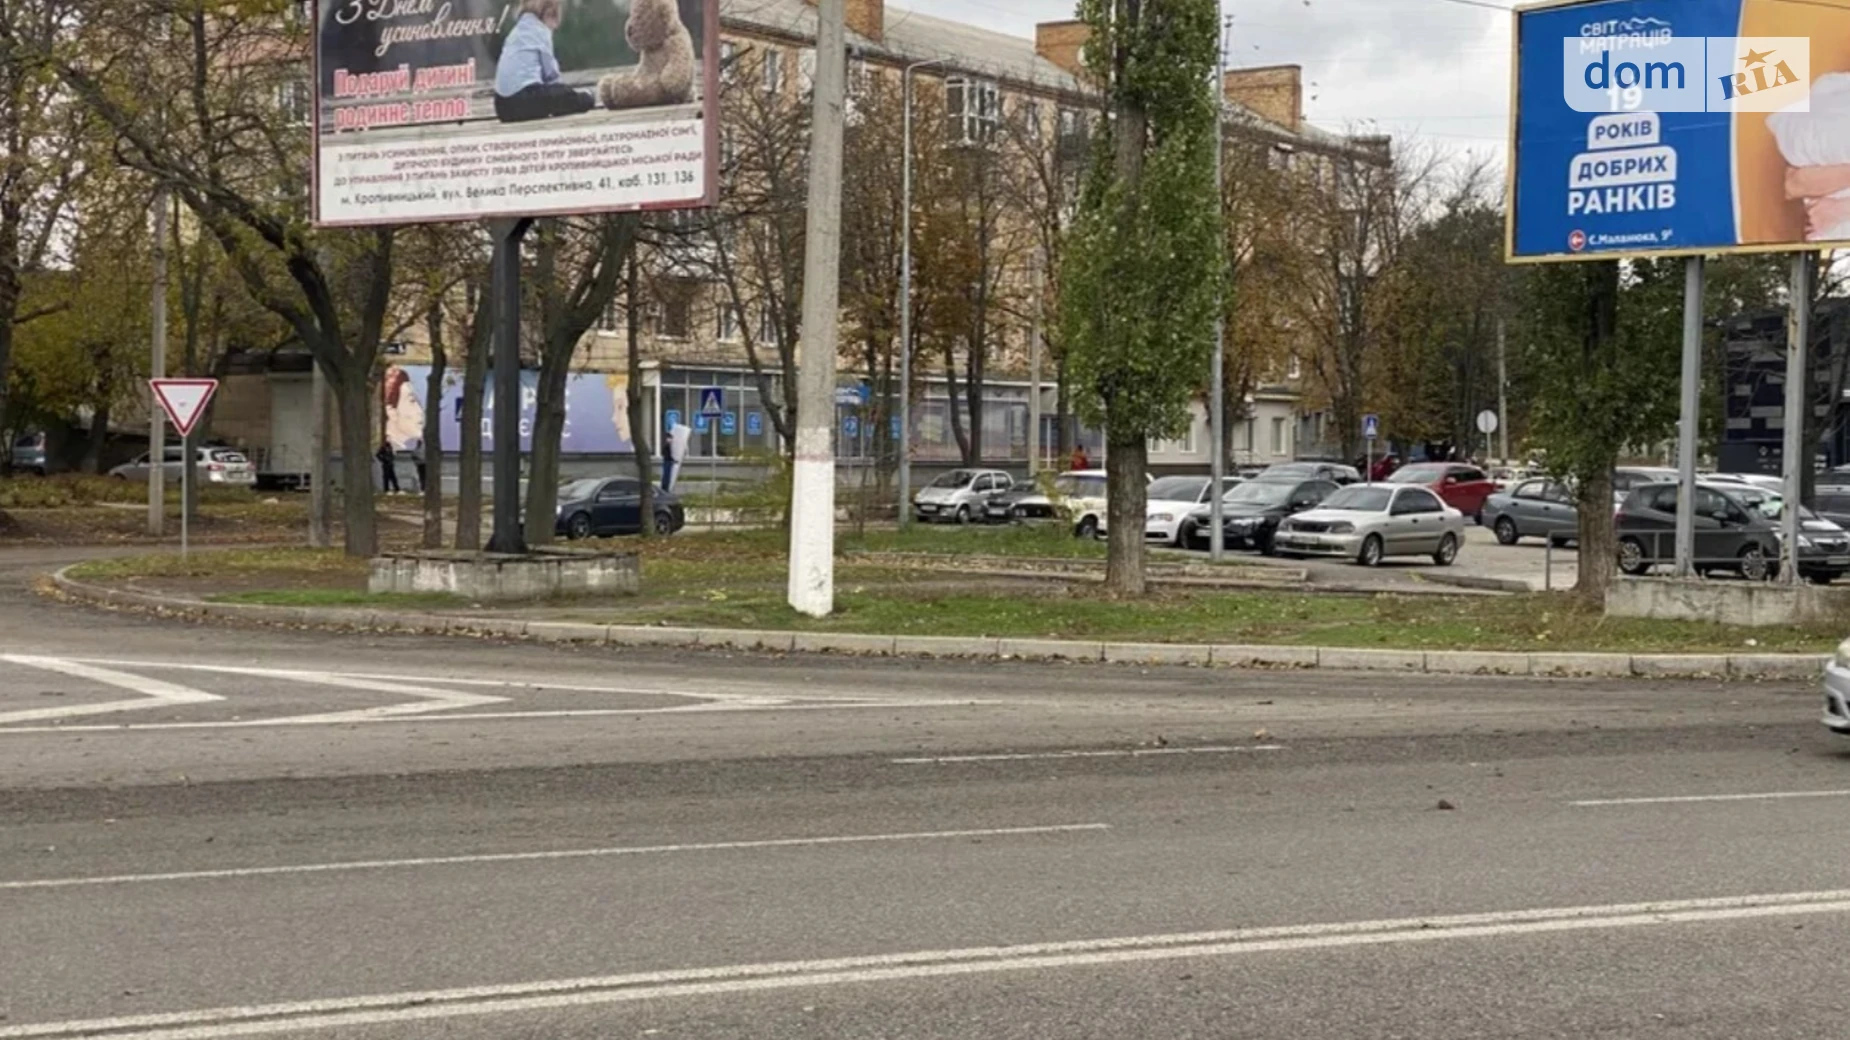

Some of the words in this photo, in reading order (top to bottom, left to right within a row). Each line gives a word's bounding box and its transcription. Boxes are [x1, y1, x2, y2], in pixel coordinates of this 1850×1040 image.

[375, 2, 510, 57] усиновлення!
[1580, 19, 1618, 37] СВІТ
[333, 63, 410, 98] Подаруй
[1606, 84, 1643, 112] 19
[333, 102, 410, 134] родинне
[1594, 120, 1653, 140] РОКІВ
[1577, 155, 1668, 181] ДОБРИХ
[466, 186, 506, 199] Велика
[675, 170, 695, 184] 136
[1568, 184, 1677, 216] РАНКІВ
